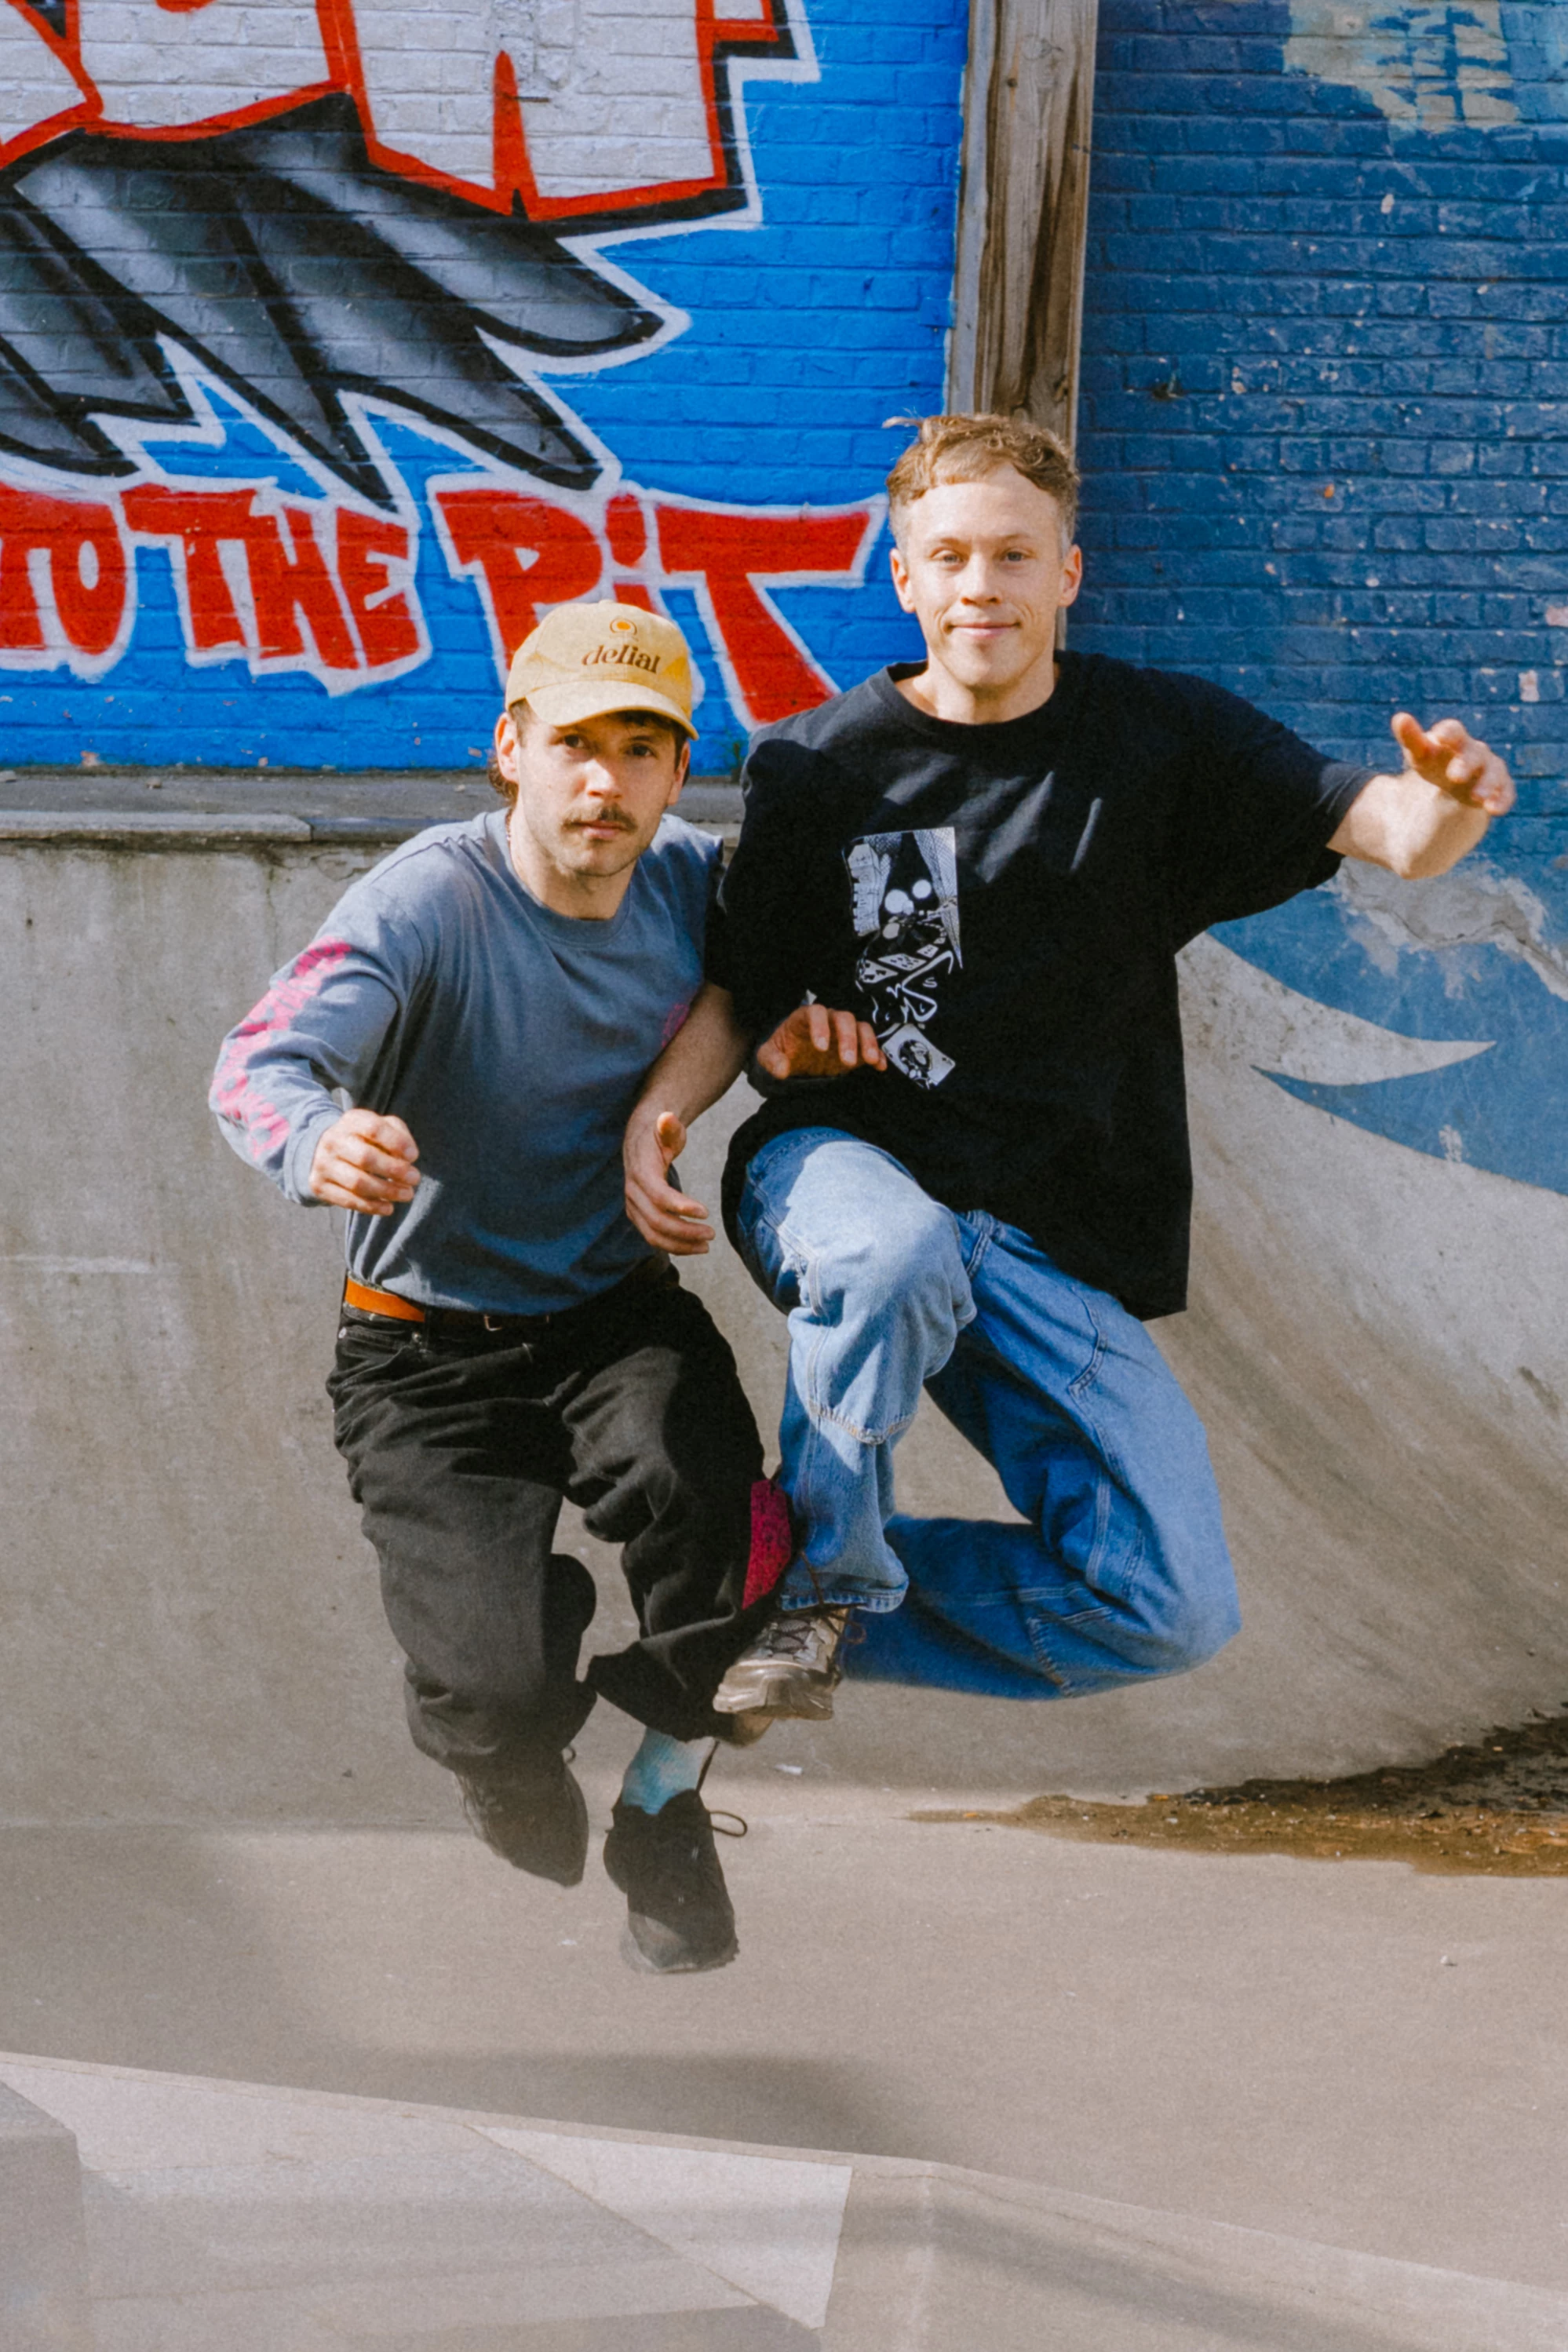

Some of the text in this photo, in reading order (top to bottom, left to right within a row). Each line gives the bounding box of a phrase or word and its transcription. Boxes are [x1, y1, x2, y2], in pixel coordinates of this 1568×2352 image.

[0, 480, 130, 659] TO
[118, 480, 424, 673] THE
[581, 644, 661, 674] delial
